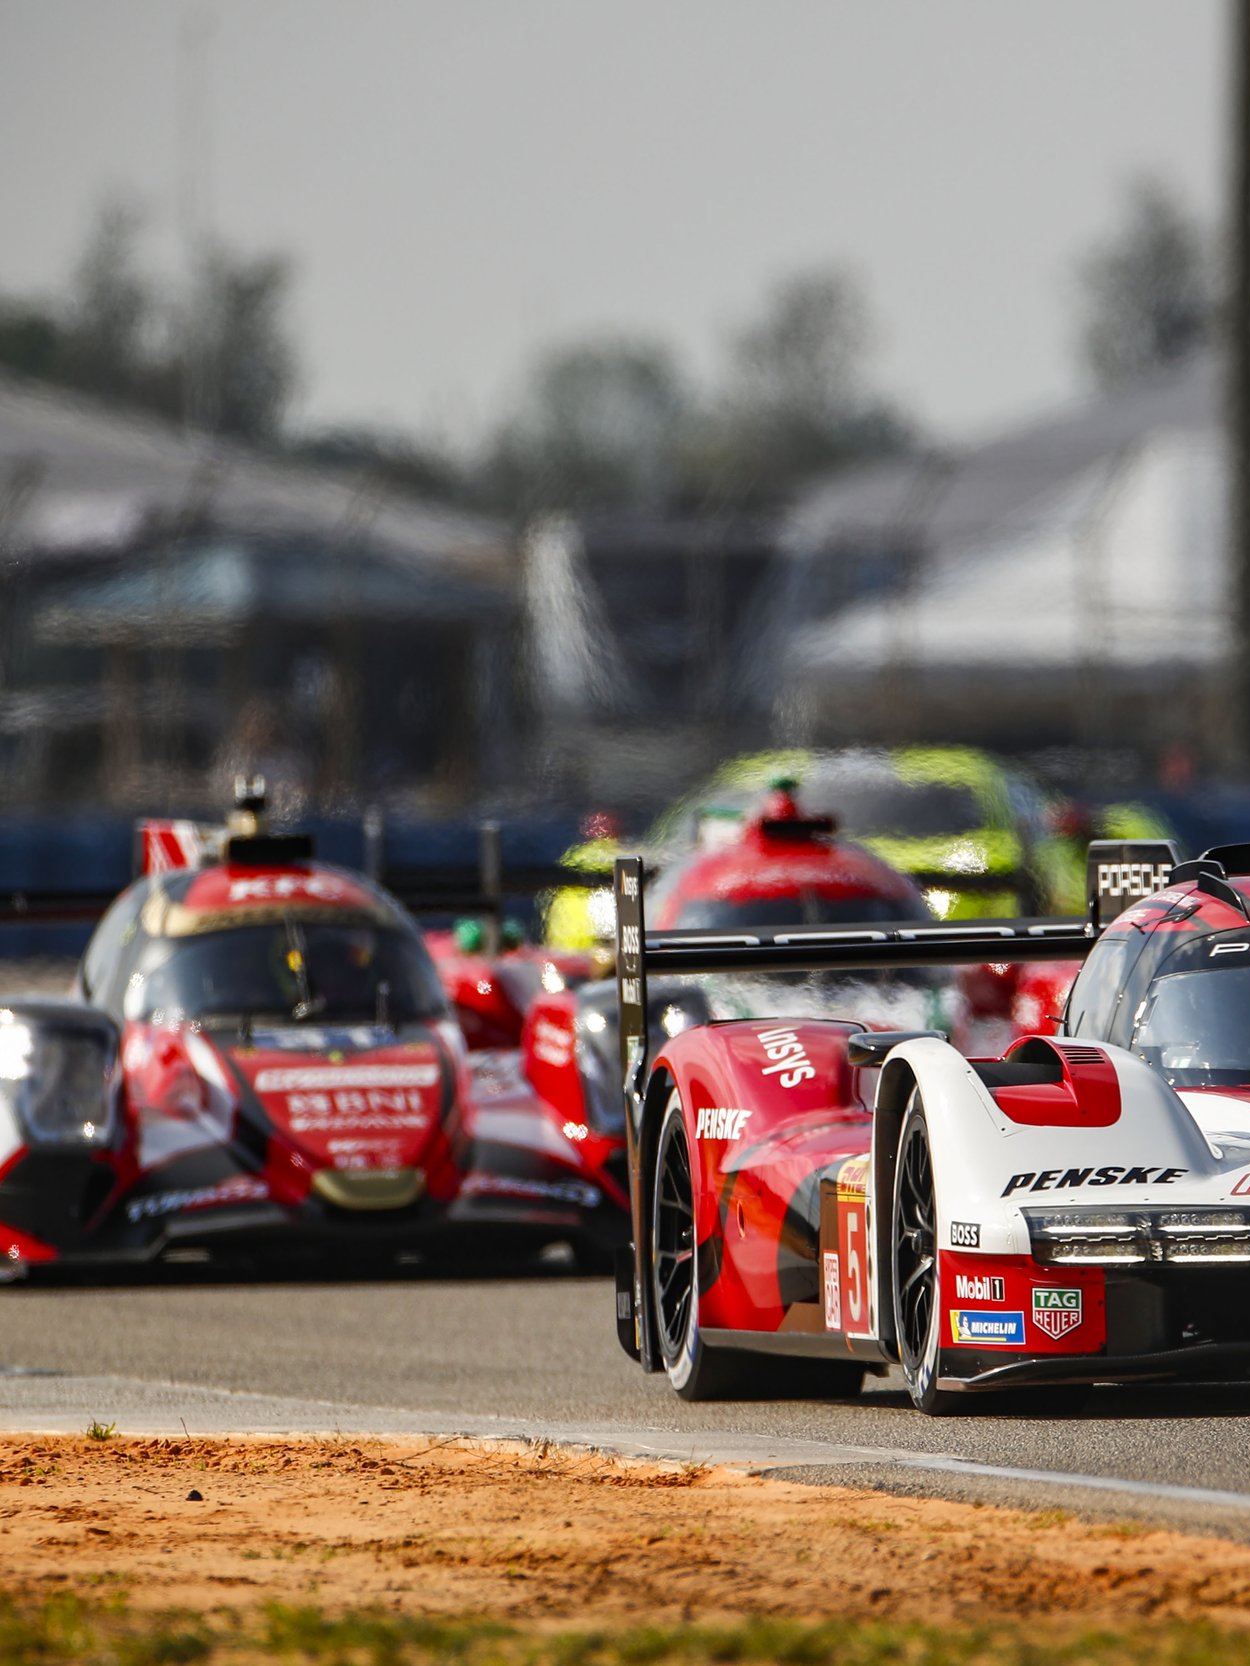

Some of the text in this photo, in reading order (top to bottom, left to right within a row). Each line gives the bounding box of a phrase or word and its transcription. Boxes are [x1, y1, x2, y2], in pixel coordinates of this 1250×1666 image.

[1098, 864, 1172, 896] PORSCHE
[622, 926, 640, 954] BOSS
[752, 1025, 816, 1088] Ansys
[695, 1108, 752, 1140] PENSKE
[1000, 1167, 1189, 1198] PENSKE
[951, 1224, 978, 1246] BOSS
[847, 1212, 862, 1321] 5
[955, 1275, 990, 1301] Mobil
[1036, 1292, 1077, 1307] TAG
[971, 1322, 1017, 1335] MICHELIN
[1035, 1311, 1078, 1335] HEUER
